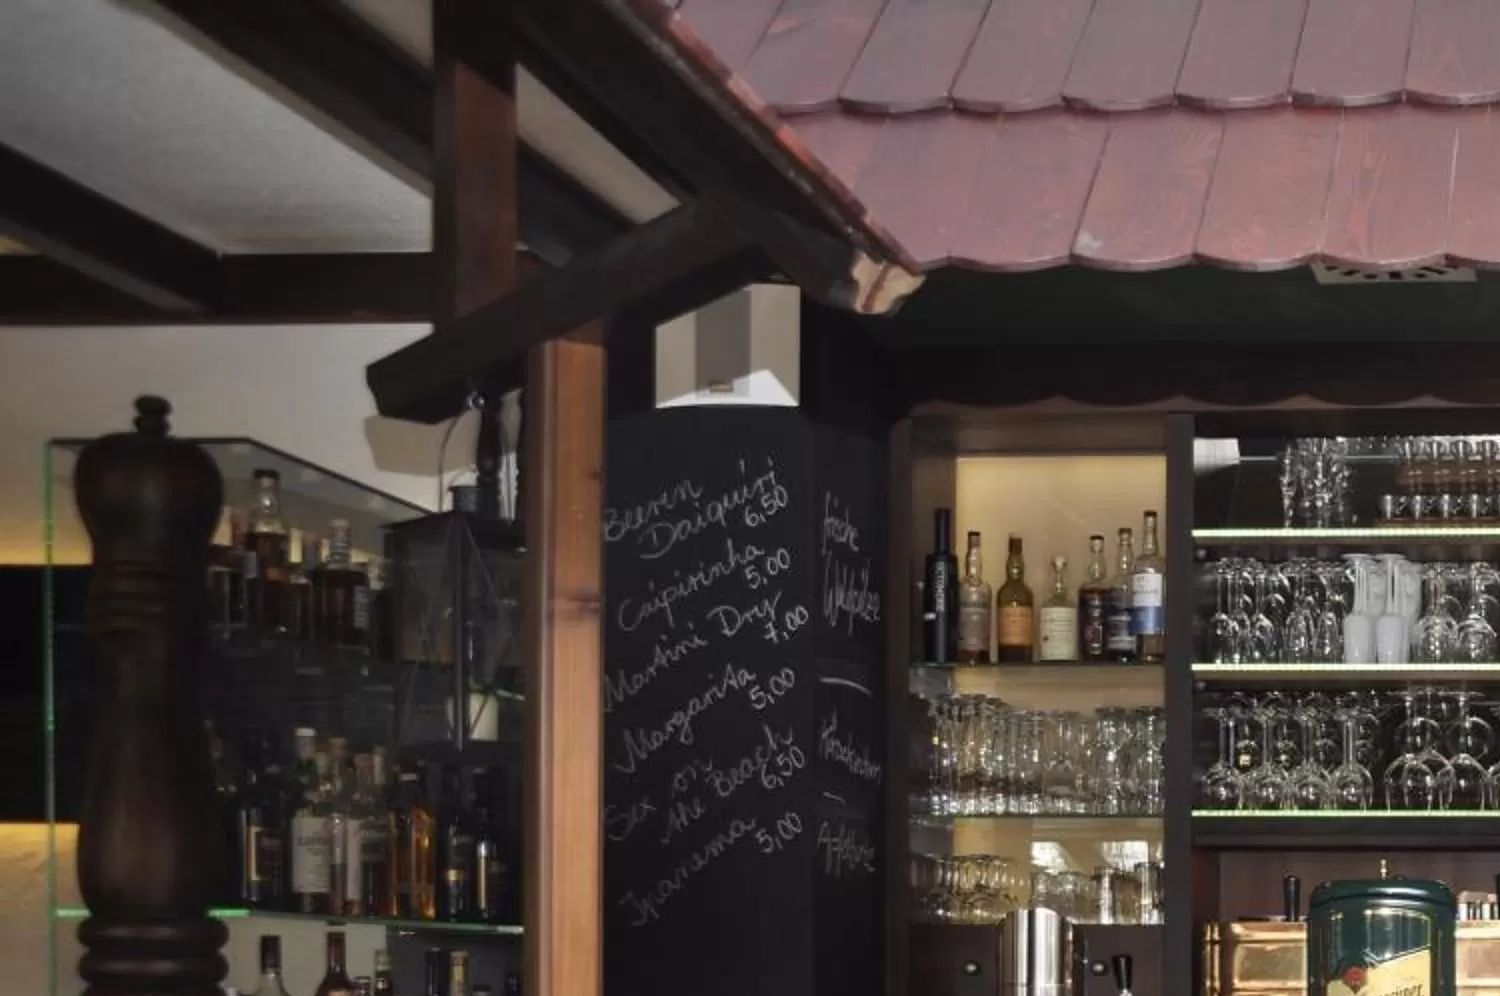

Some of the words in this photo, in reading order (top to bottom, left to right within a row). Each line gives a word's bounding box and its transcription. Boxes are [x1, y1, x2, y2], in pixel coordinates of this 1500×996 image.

[638, 456, 778, 559] Daiquiri
[744, 484, 789, 528] 6,50
[744, 546, 791, 590] 5,00
[749, 667, 797, 711] 5,00
[614, 661, 758, 774] Margarita
[759, 744, 807, 790] 6,50
[753, 812, 804, 855] 5,00
